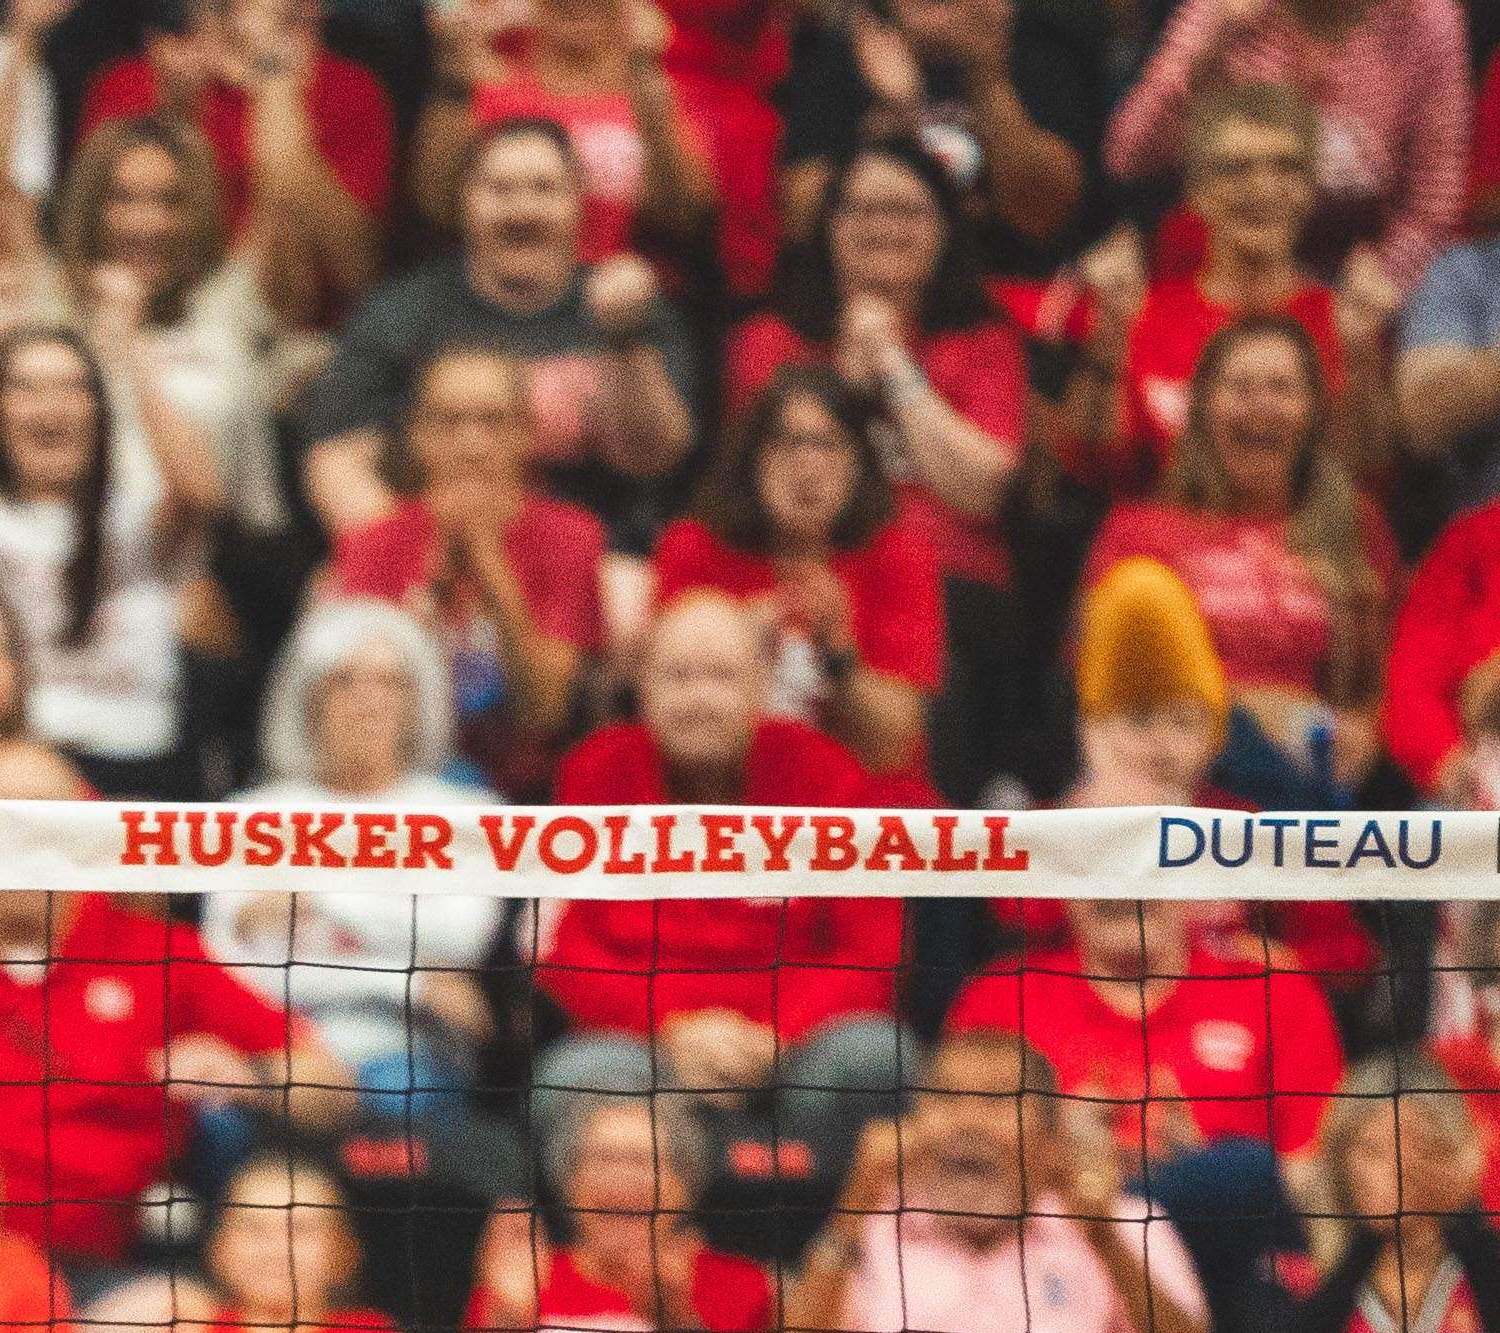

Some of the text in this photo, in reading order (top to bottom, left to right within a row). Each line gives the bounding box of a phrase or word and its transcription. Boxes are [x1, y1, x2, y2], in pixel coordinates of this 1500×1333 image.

[120, 810, 1031, 875] HUSKER VOLLEYBALL
[1158, 816, 1443, 869] DUTEAU
